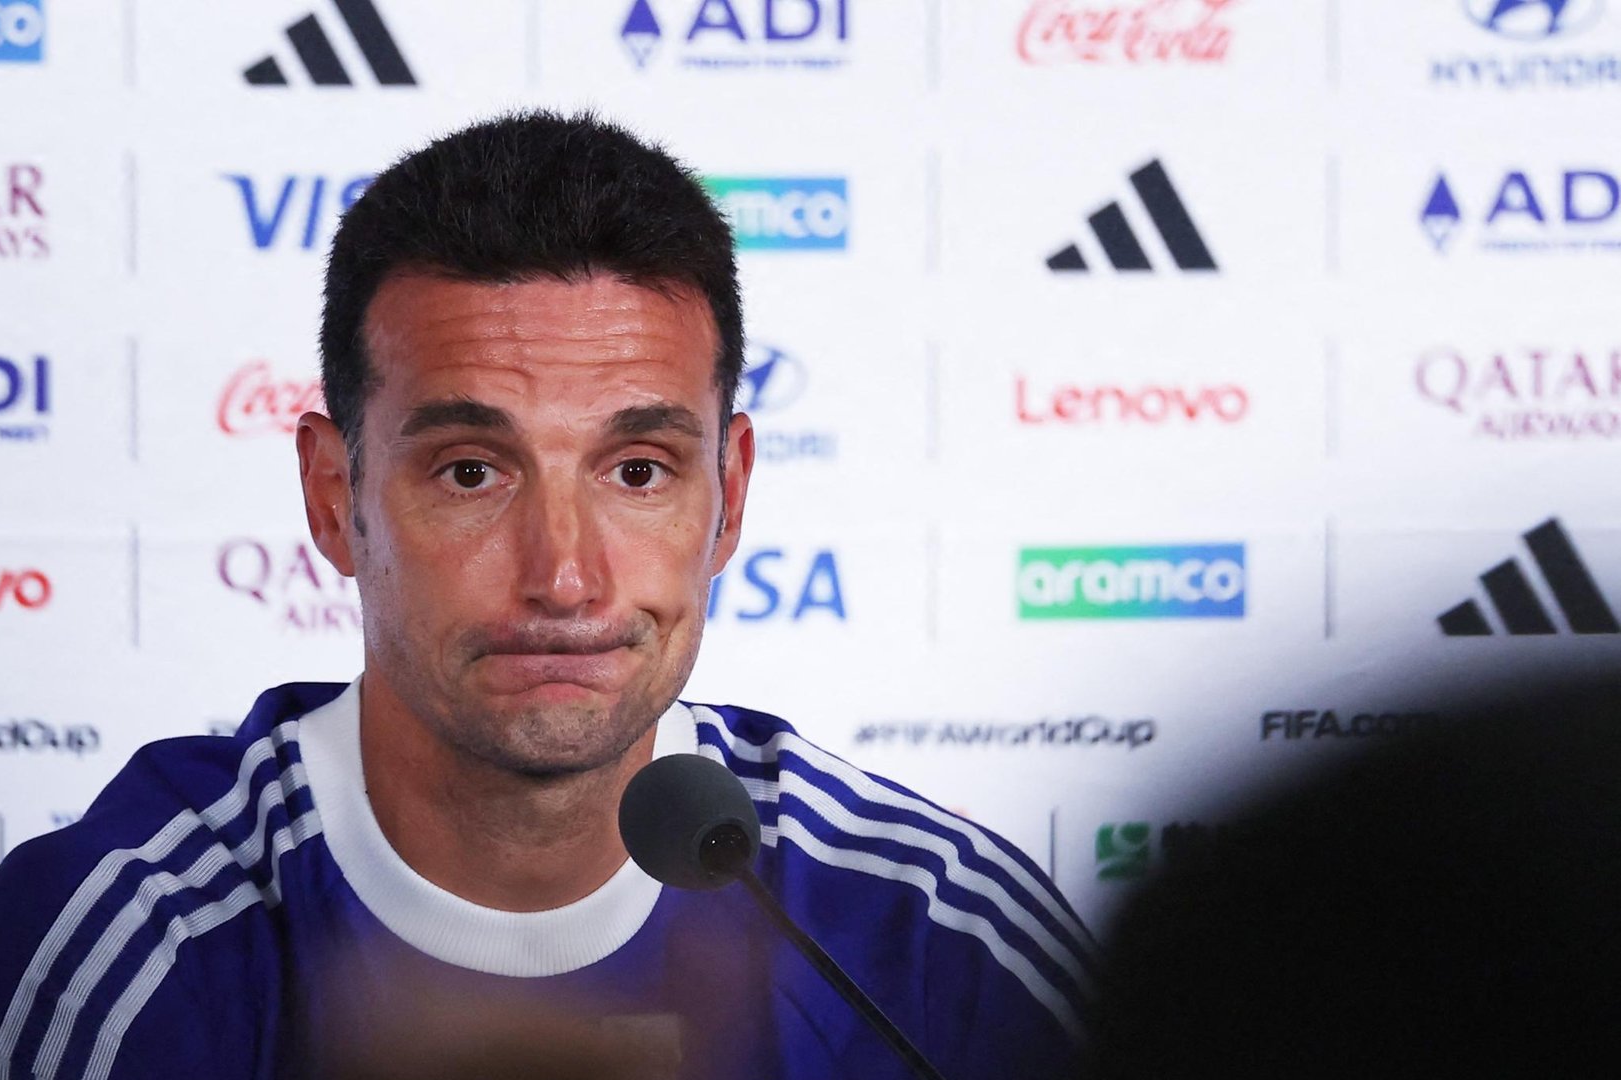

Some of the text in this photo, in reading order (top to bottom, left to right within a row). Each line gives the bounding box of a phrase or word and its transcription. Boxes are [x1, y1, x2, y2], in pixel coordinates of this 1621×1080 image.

[684, 0, 849, 43] ADI
[220, 173, 374, 249] VI
[724, 190, 847, 239] mco
[1485, 169, 1621, 225] AD
[1013, 376, 1250, 426] Lenovo
[707, 550, 848, 620] ISA
[1018, 556, 1245, 607] aramco
